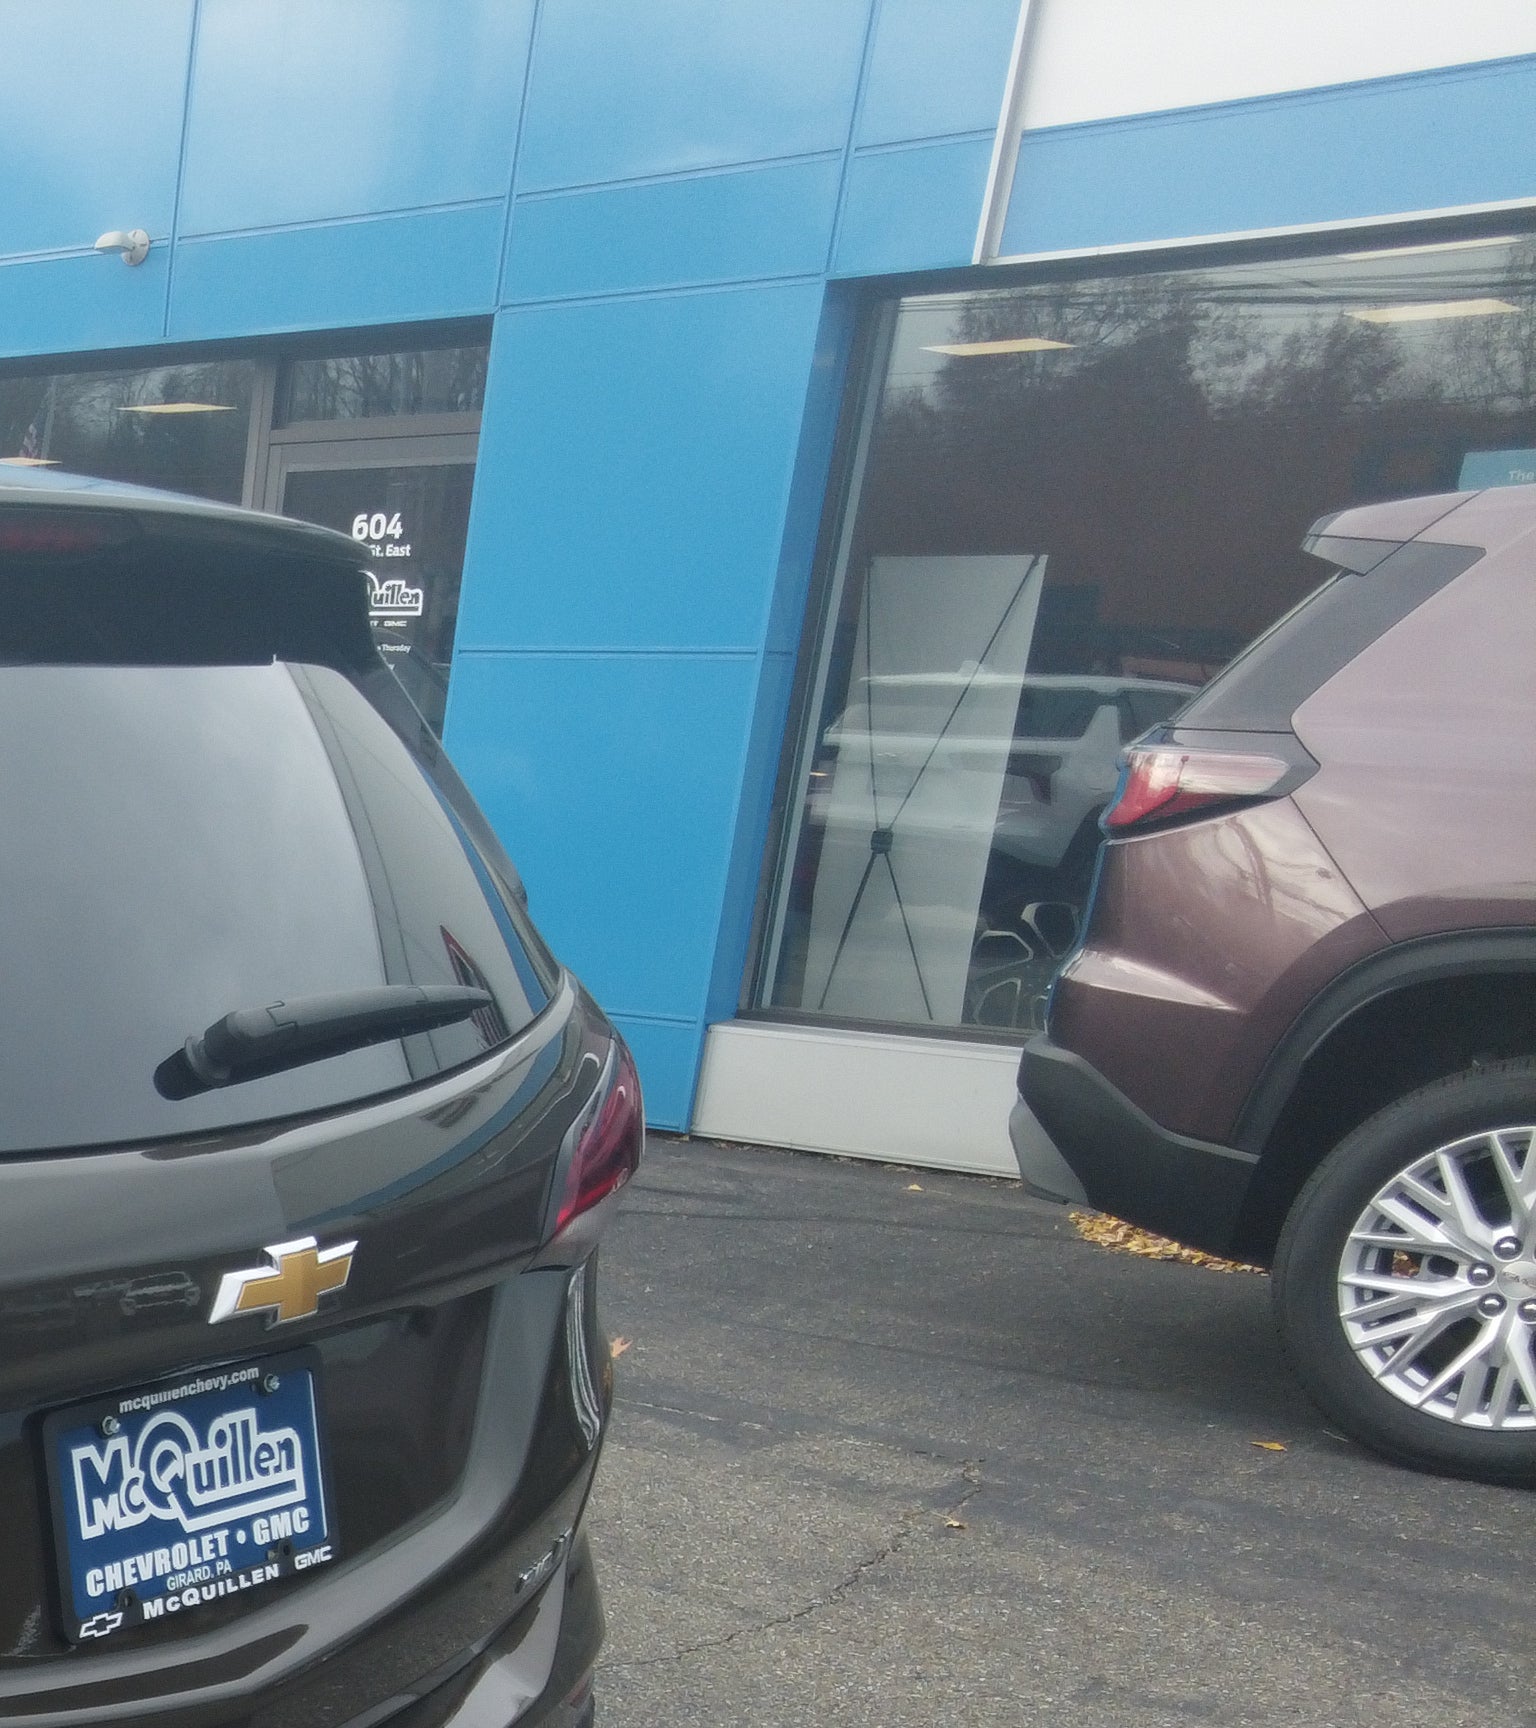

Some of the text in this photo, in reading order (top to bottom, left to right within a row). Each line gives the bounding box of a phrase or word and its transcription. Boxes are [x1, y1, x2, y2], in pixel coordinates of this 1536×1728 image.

[352, 513, 403, 541] 604
[386, 544, 411, 557] East
[382, 643, 411, 653] Thursday
[71, 1407, 307, 1540] McQuillen
[85, 1506, 310, 1598] CHEVROLET GMC
[294, 1545, 334, 1570] GMC
[216, 1559, 232, 1576] PA
